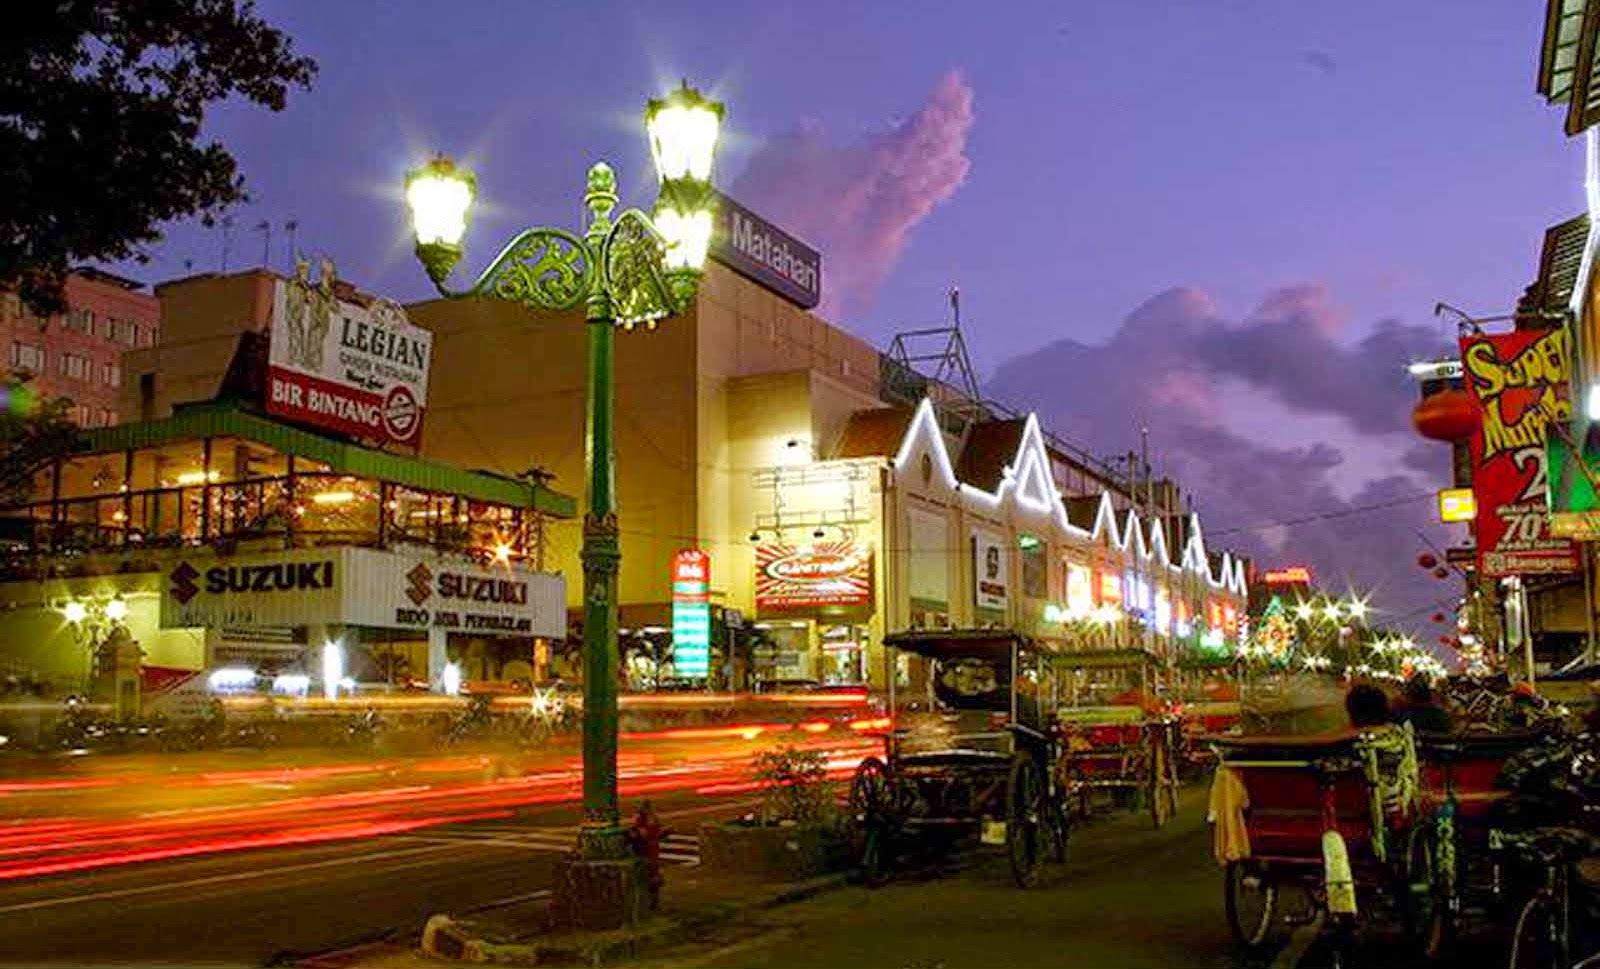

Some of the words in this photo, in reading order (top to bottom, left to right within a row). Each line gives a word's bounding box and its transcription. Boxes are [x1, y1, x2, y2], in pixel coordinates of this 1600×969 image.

[733, 211, 819, 293] Matahari
[341, 317, 427, 369] LEGIAN
[271, 378, 303, 408] BIR
[307, 388, 380, 427] BINTANG
[205, 561, 334, 593] SUZUKI
[438, 571, 528, 605] SUZUKI
